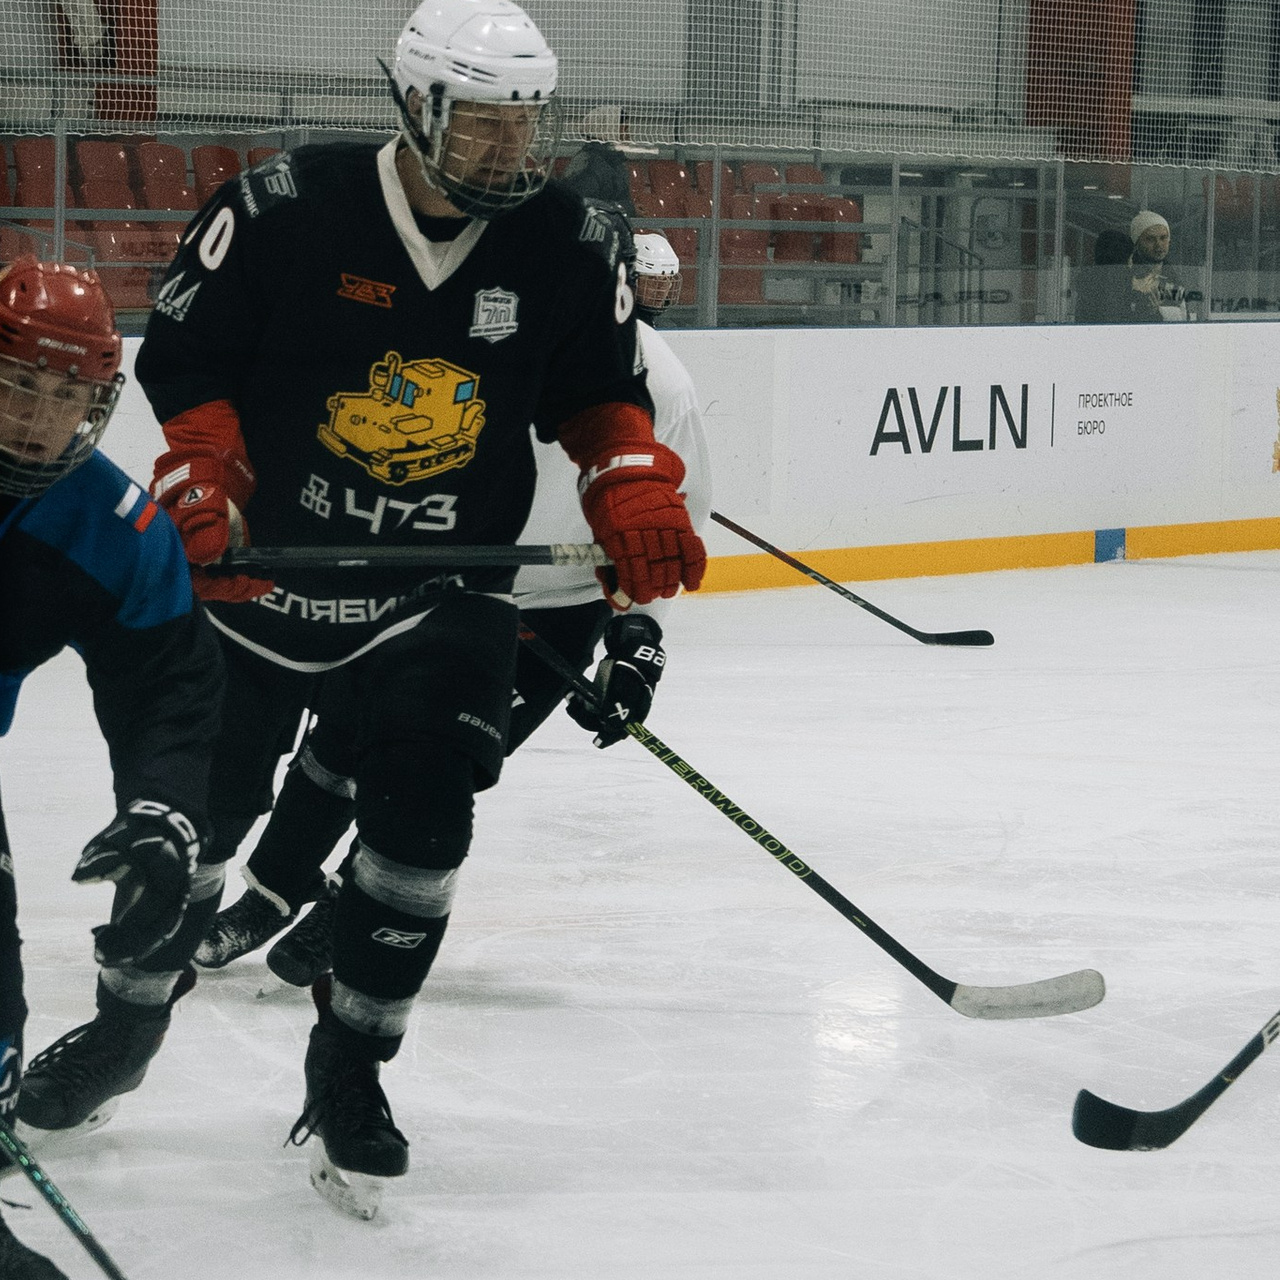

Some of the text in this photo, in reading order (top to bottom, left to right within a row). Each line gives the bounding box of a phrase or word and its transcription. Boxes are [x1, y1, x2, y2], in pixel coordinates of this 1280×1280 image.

[869, 382, 1029, 457] AVLN
[1078, 392, 1133, 409] ПРОЕКТНОЕ
[1077, 420, 1106, 436] БЮРО
[624, 721, 813, 879] SHERWOOD
